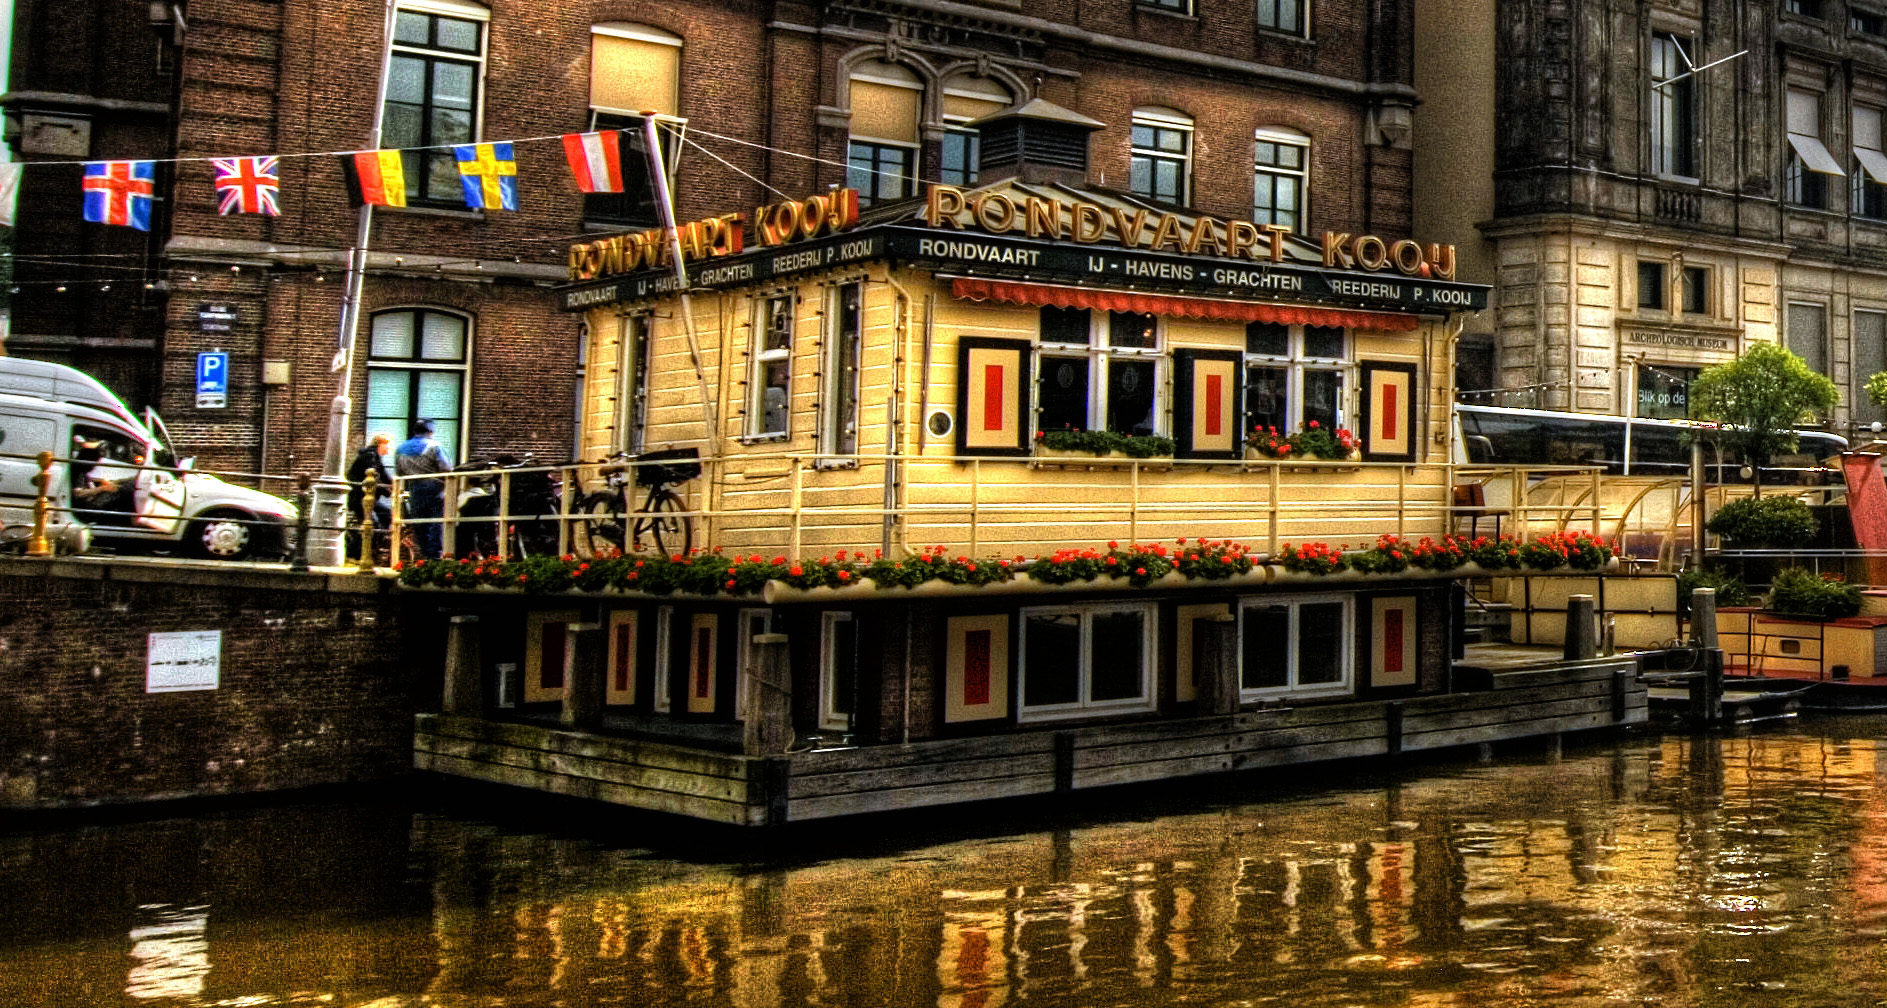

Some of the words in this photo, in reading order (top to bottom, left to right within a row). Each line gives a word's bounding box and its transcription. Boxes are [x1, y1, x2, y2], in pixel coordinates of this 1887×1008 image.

[569, 212, 744, 280] RONDVAART
[928, 184, 1292, 263] RONDVAART
[567, 286, 617, 307] RONDVAART
[701, 264, 753, 286] GRACHTEN
[773, 248, 821, 275] REEDERIJ
[841, 239, 873, 260] KOOIJ
[919, 238, 1040, 266] RONDVAART
[1088, 256, 1104, 272] IJ
[1125, 260, 1193, 280] HAVENS
[1213, 268, 1301, 291] GRACHTEN
[1332, 279, 1401, 300] REEDERIJ
[1432, 289, 1471, 306] KOOIJ
[204, 357, 221, 377] P
[1697, 337, 1727, 349] MUSEUM
[1639, 390, 1655, 403] Blik
[1658, 392, 1670, 405] op
[1673, 392, 1685, 404] de
